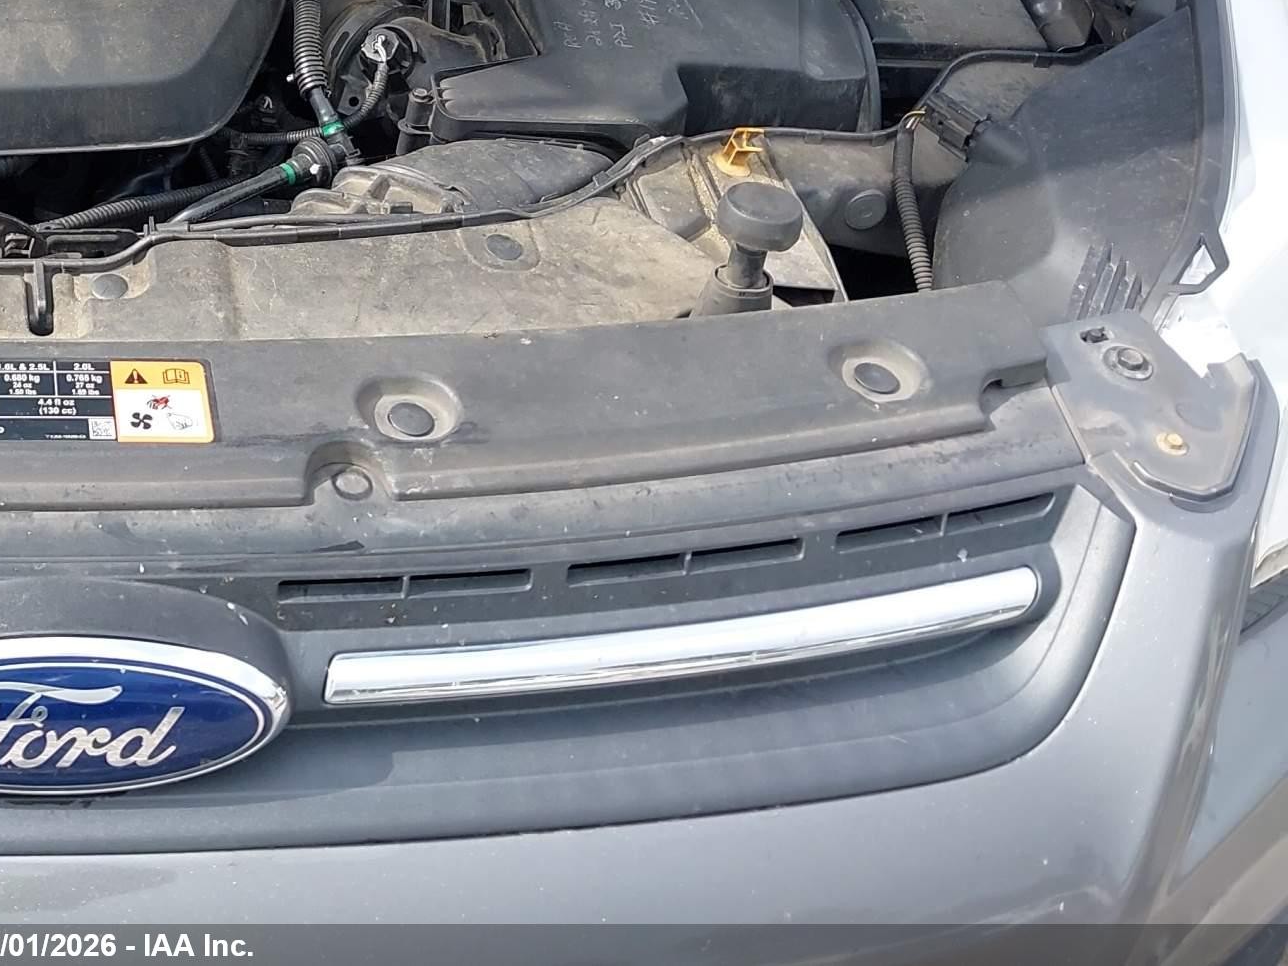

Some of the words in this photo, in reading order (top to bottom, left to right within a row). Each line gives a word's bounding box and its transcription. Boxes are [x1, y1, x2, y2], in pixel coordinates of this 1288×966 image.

[28, 363, 50, 371] 2.5L
[73, 362, 95, 371] 2.0L
[28, 374, 41, 384] kg
[90, 374, 103, 384] kg
[38, 407, 60, 415] (130
[61, 407, 77, 415] cc)
